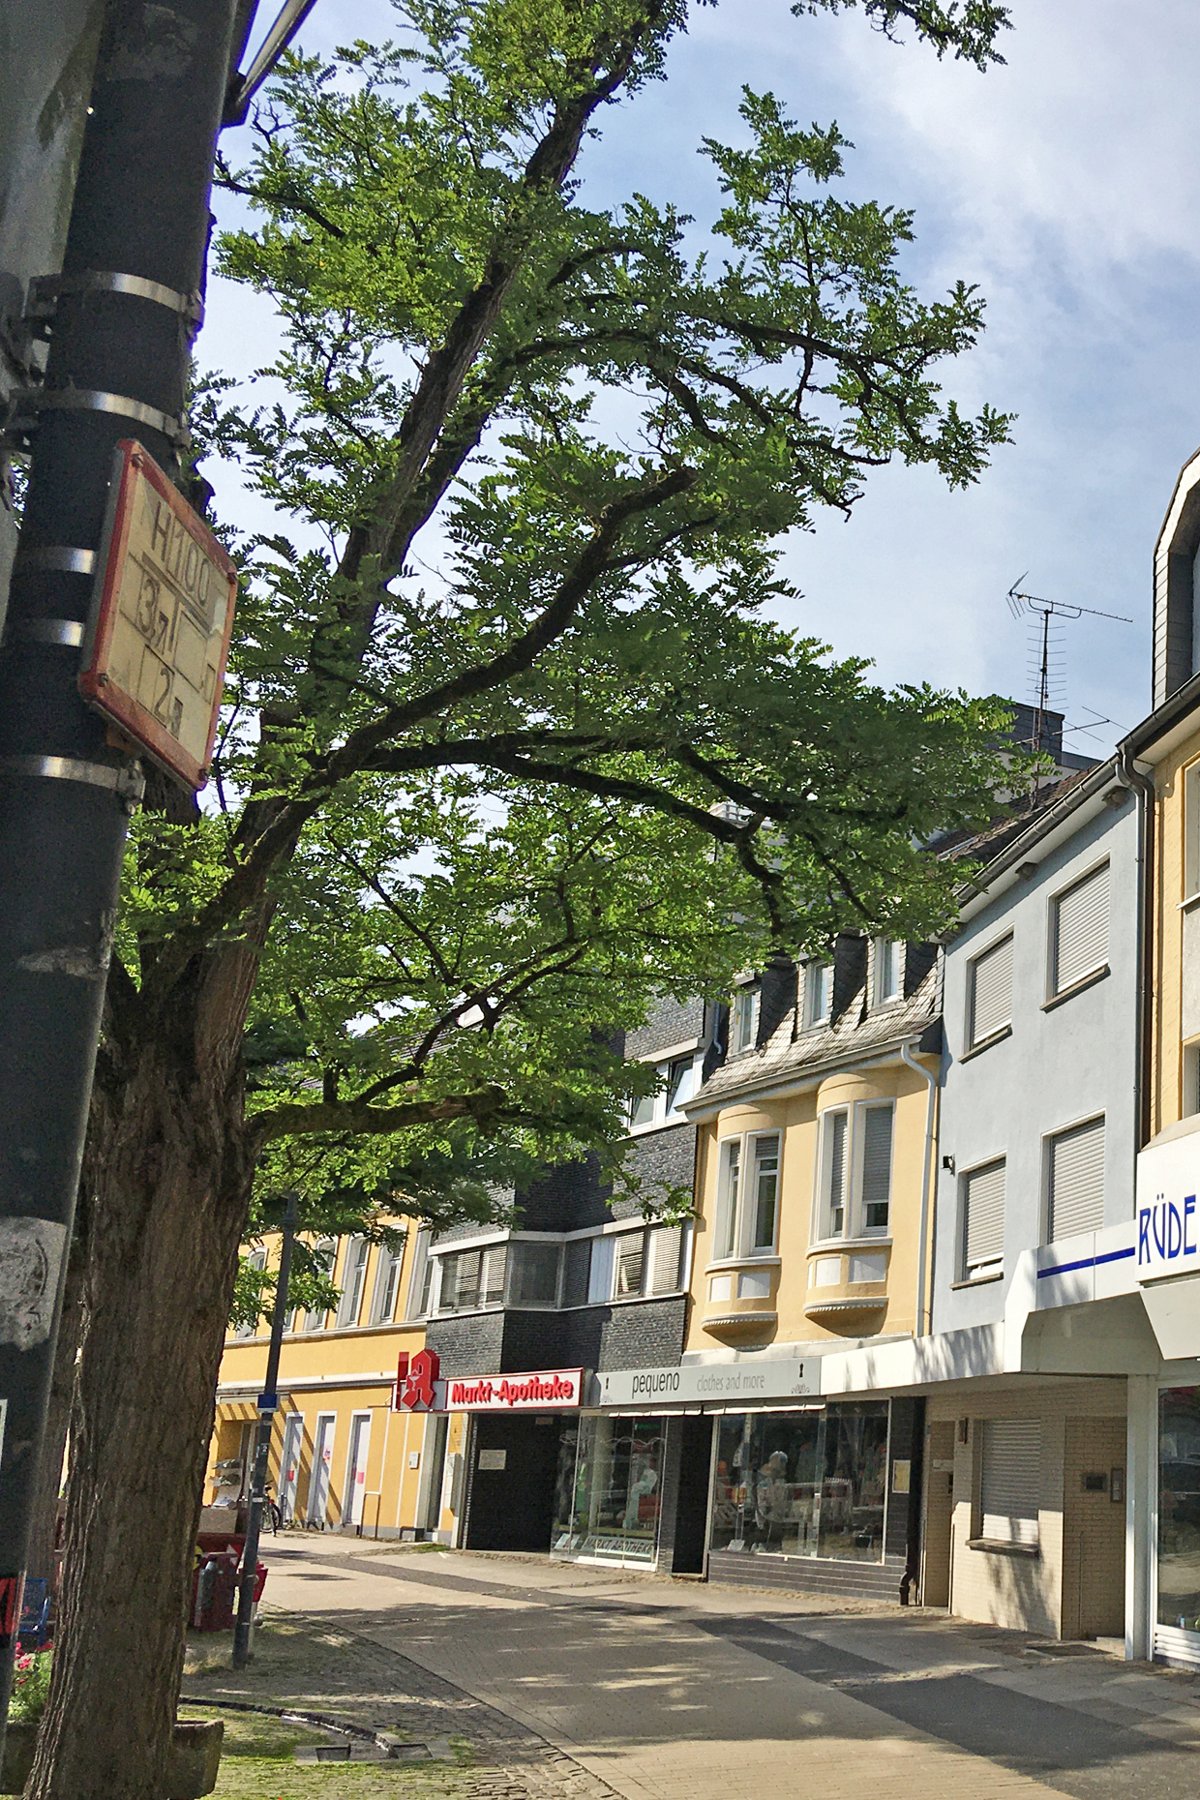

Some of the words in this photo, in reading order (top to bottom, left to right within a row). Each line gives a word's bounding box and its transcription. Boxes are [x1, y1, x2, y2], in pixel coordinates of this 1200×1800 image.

[152, 500, 209, 607] H100
[451, 1374, 574, 1406] Markt-Apotheke
[632, 1371, 680, 1399] pequeno
[696, 1373, 724, 1392] clothes
[725, 1371, 741, 1391] and
[742, 1375, 765, 1390] more
